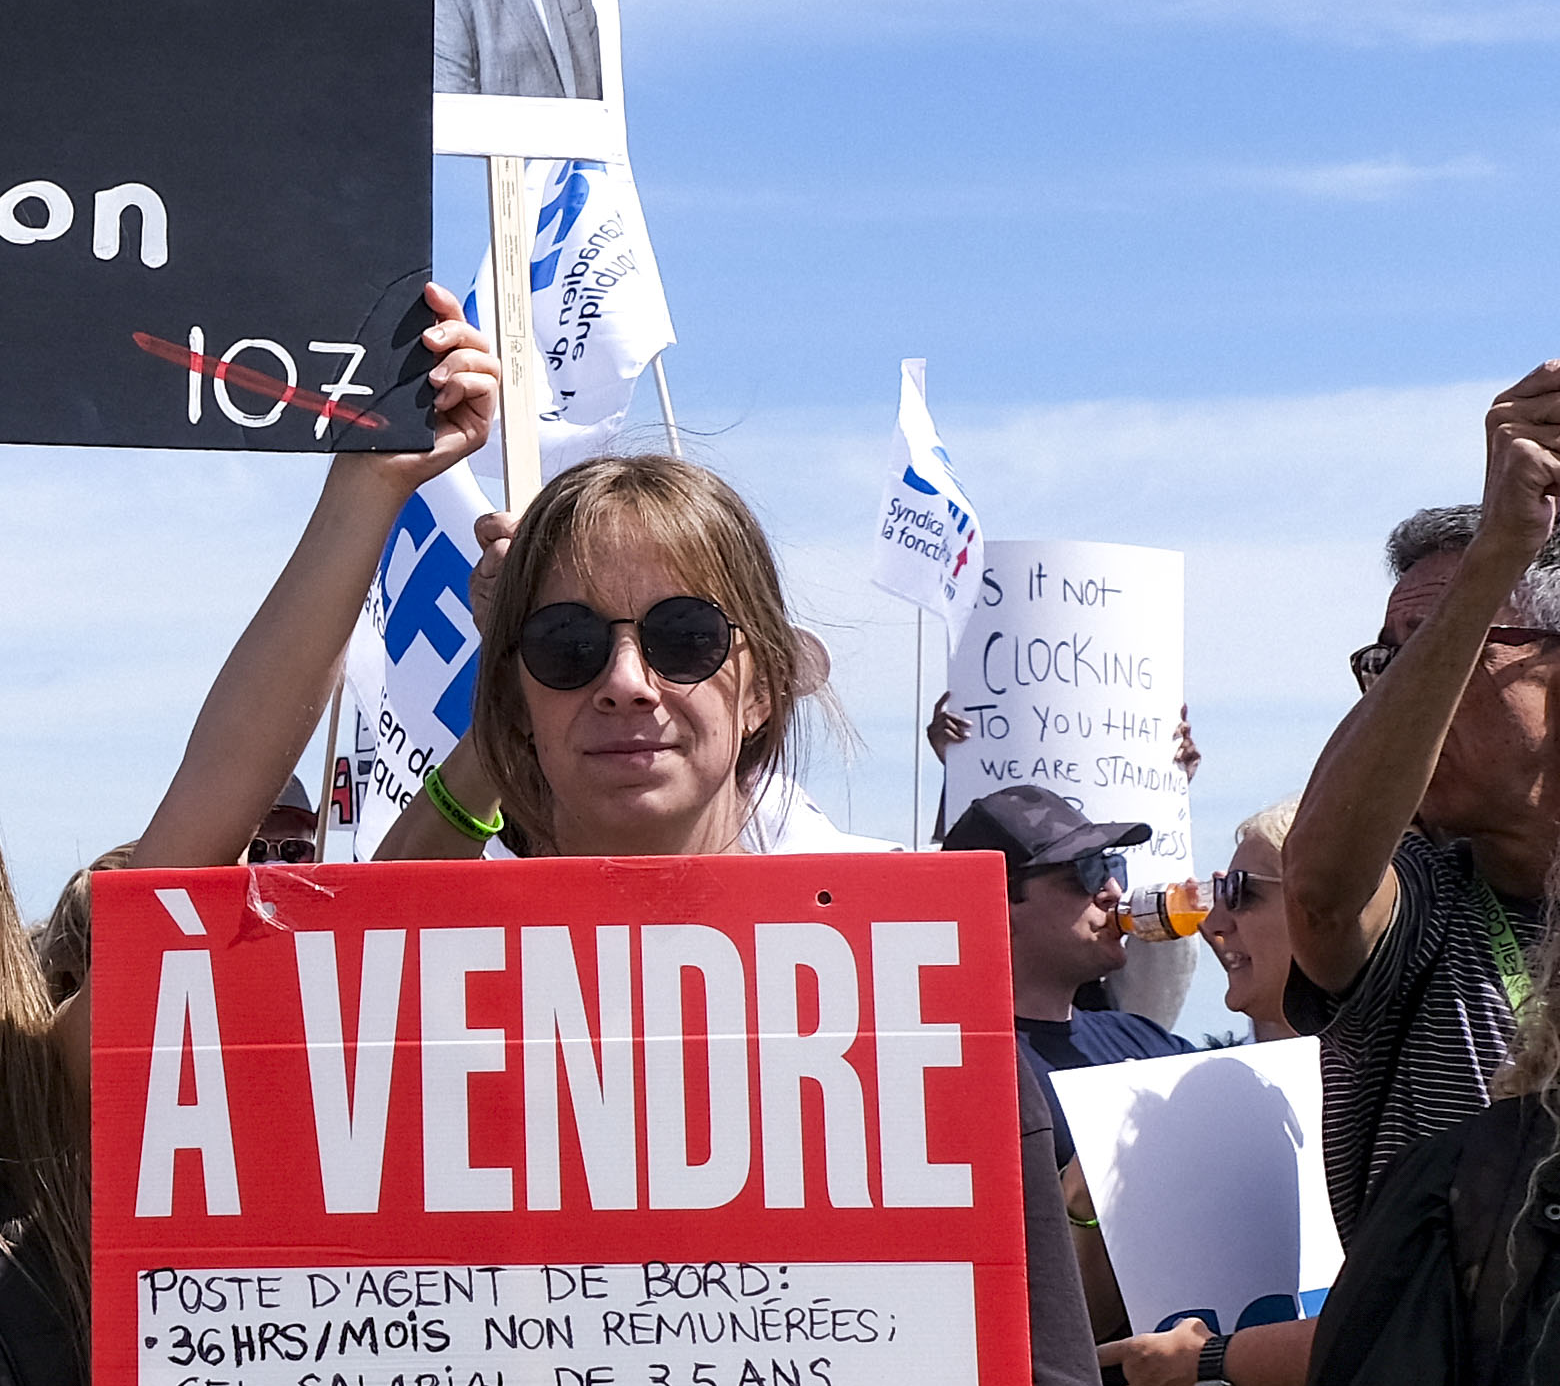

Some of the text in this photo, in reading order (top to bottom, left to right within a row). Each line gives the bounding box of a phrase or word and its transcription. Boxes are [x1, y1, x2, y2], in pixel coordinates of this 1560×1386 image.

[186, 323, 368, 439] 107
[974, 568, 1004, 608] S
[983, 631, 1153, 696] CLOCKING
[1032, 705, 1093, 743] YOU
[980, 755, 1187, 795] WE ARE STANDING
[135, 888, 974, 1218] À VENDRE
[143, 1262, 792, 1317] POSTE D'AGENT DE BORD:
[485, 1313, 575, 1351] NON
